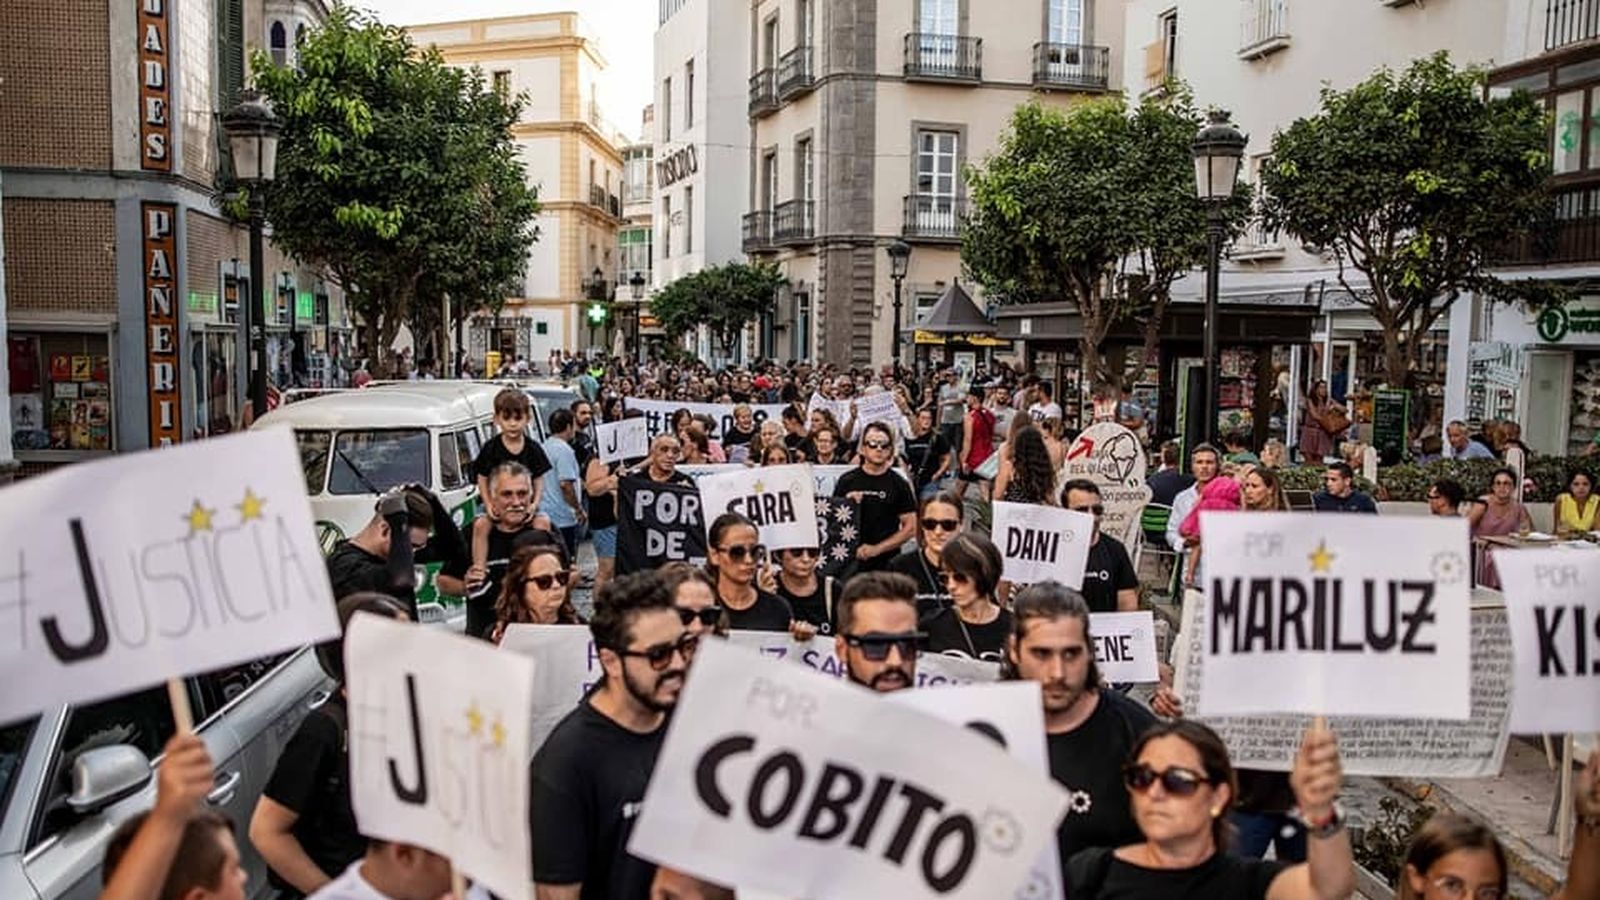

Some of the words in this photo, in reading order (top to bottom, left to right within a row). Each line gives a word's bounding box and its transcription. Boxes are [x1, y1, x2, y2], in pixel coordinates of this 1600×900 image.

[635, 489, 699, 525] POR
[727, 491, 796, 527] SARA
[646, 528, 686, 559] DE
[1006, 526, 1060, 564] DANI
[1210, 577, 1436, 655] MARILUZ
[1092, 635, 1134, 662] ENE
[693, 734, 977, 894] COBITO
